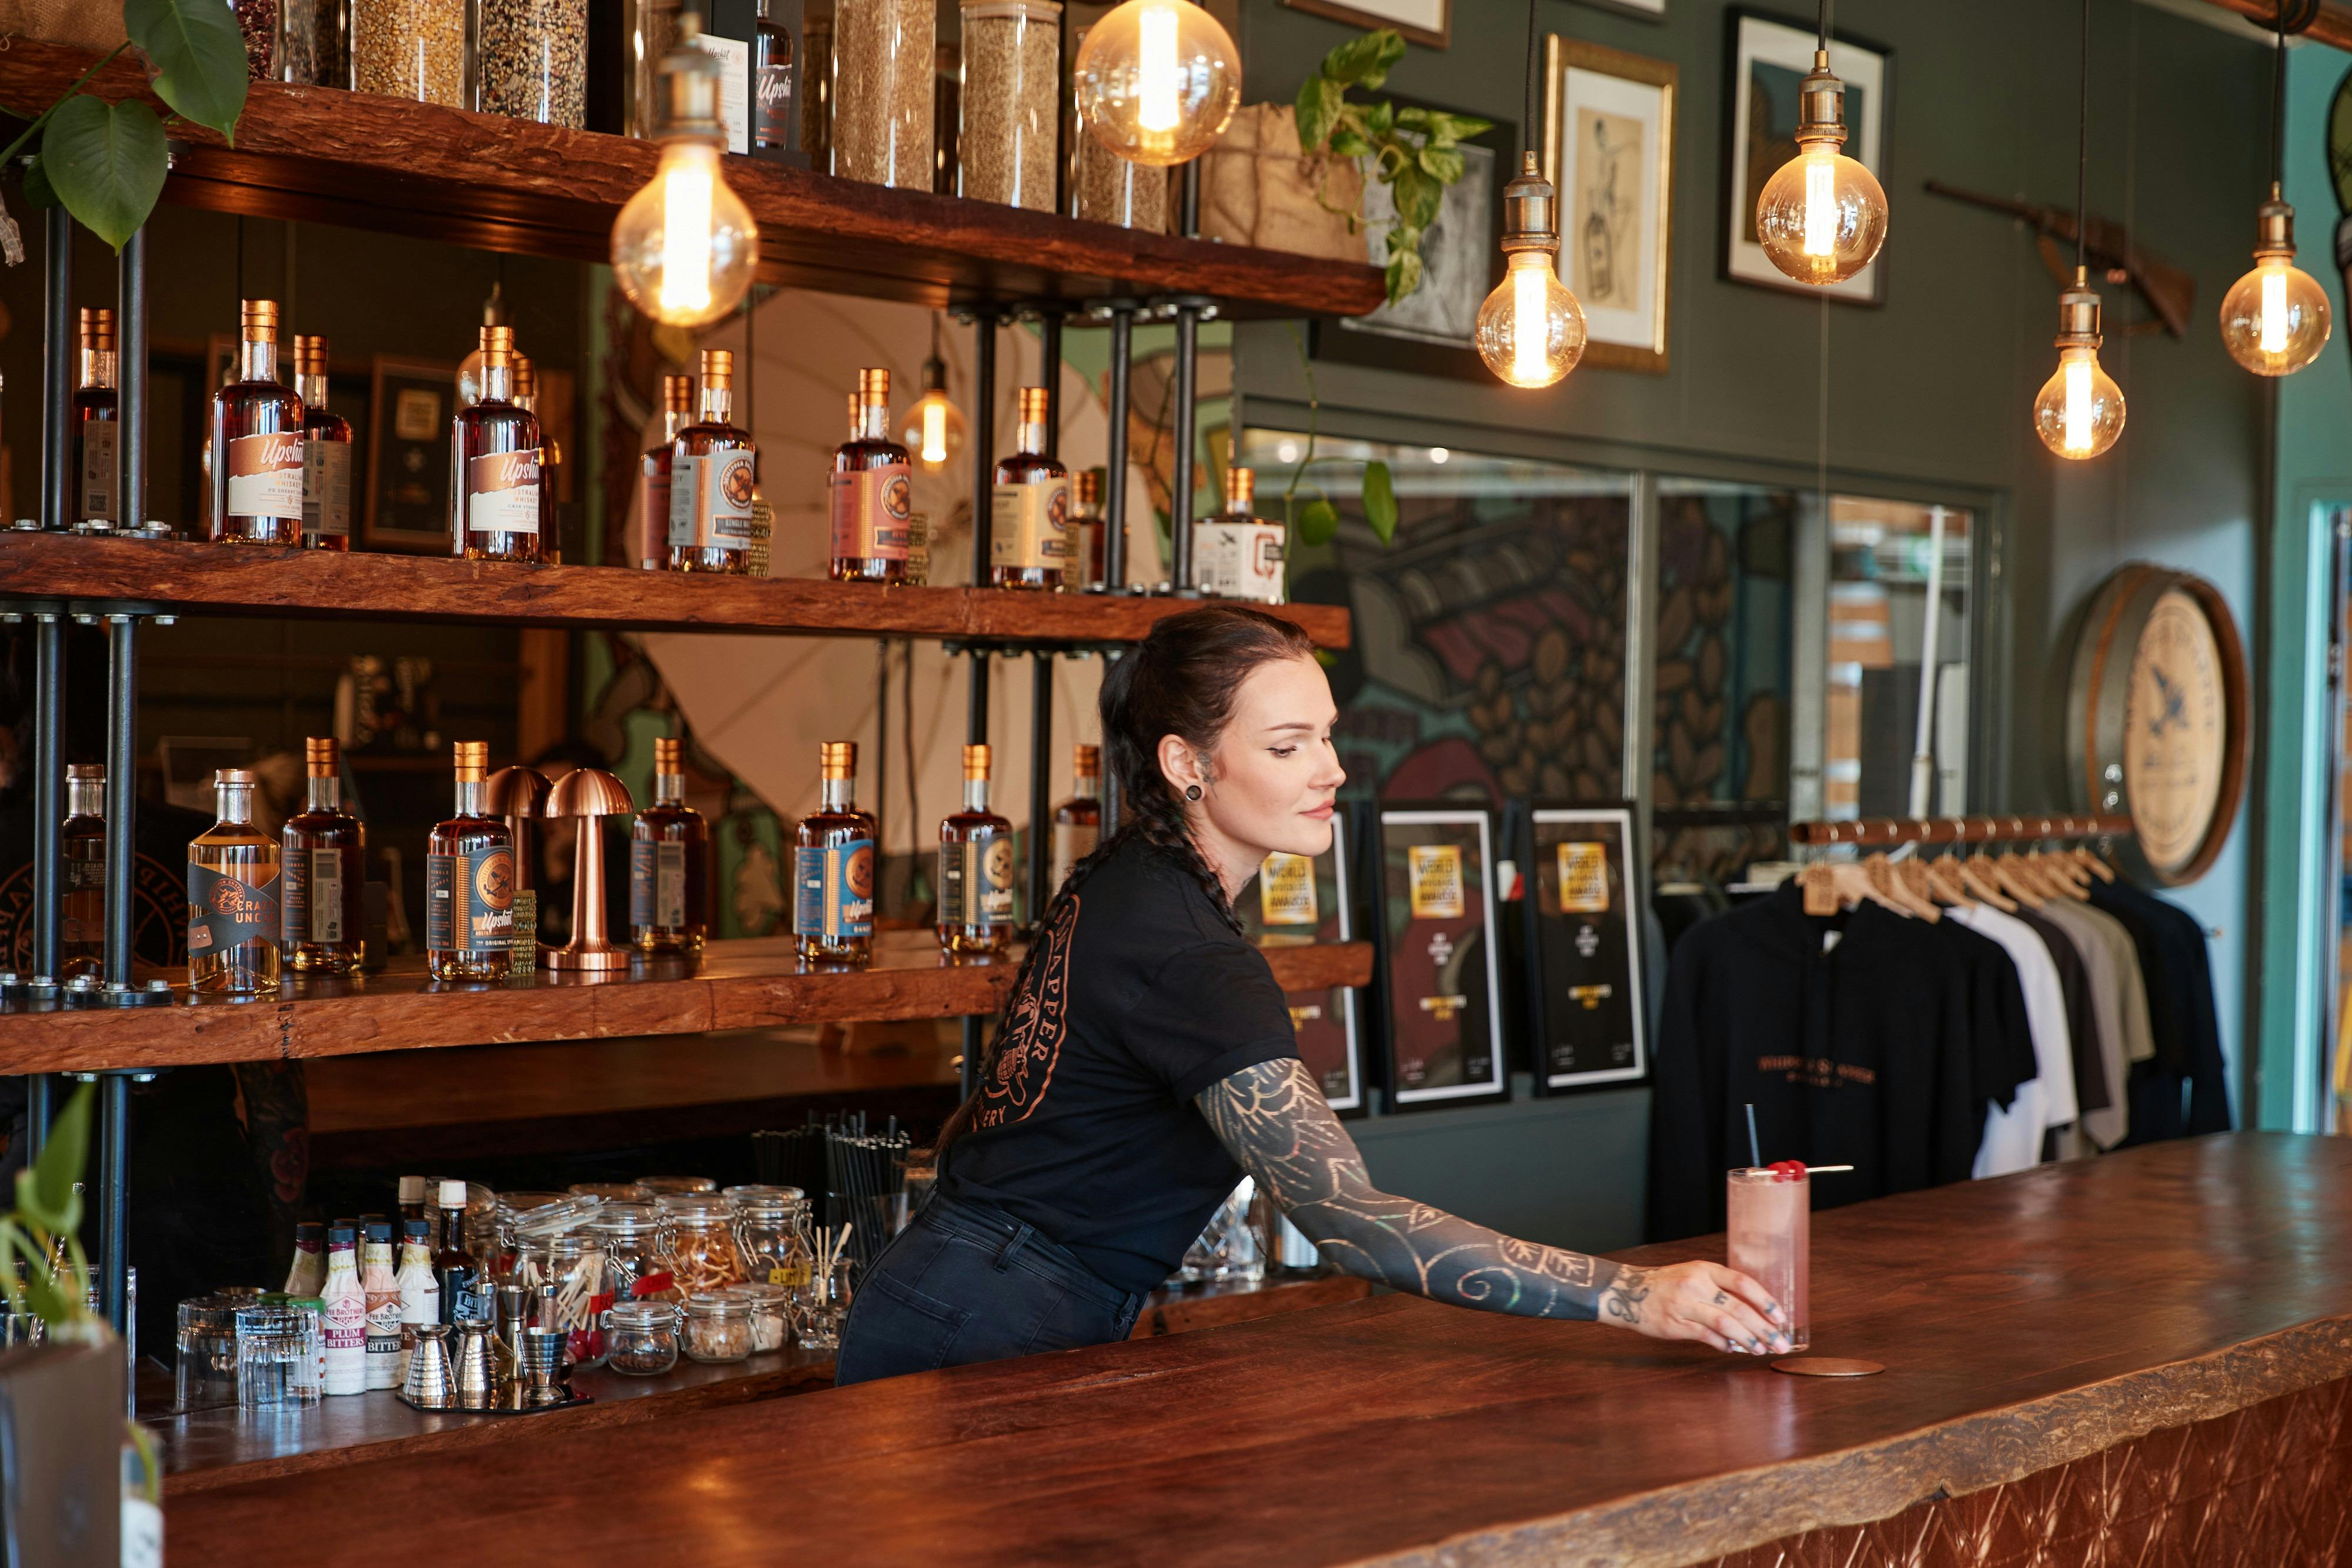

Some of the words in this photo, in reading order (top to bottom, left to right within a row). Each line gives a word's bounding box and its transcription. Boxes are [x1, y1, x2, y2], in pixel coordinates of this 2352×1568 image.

[236, 900, 274, 911] CRAZY
[235, 912, 275, 923] UNCLE
[482, 908, 513, 933] Upshot
[336, 1308, 363, 1316] BROTHER
[332, 1329, 360, 1338] PLUM
[327, 1338, 364, 1348] BITTERS
[368, 1340, 401, 1352] BITTER
